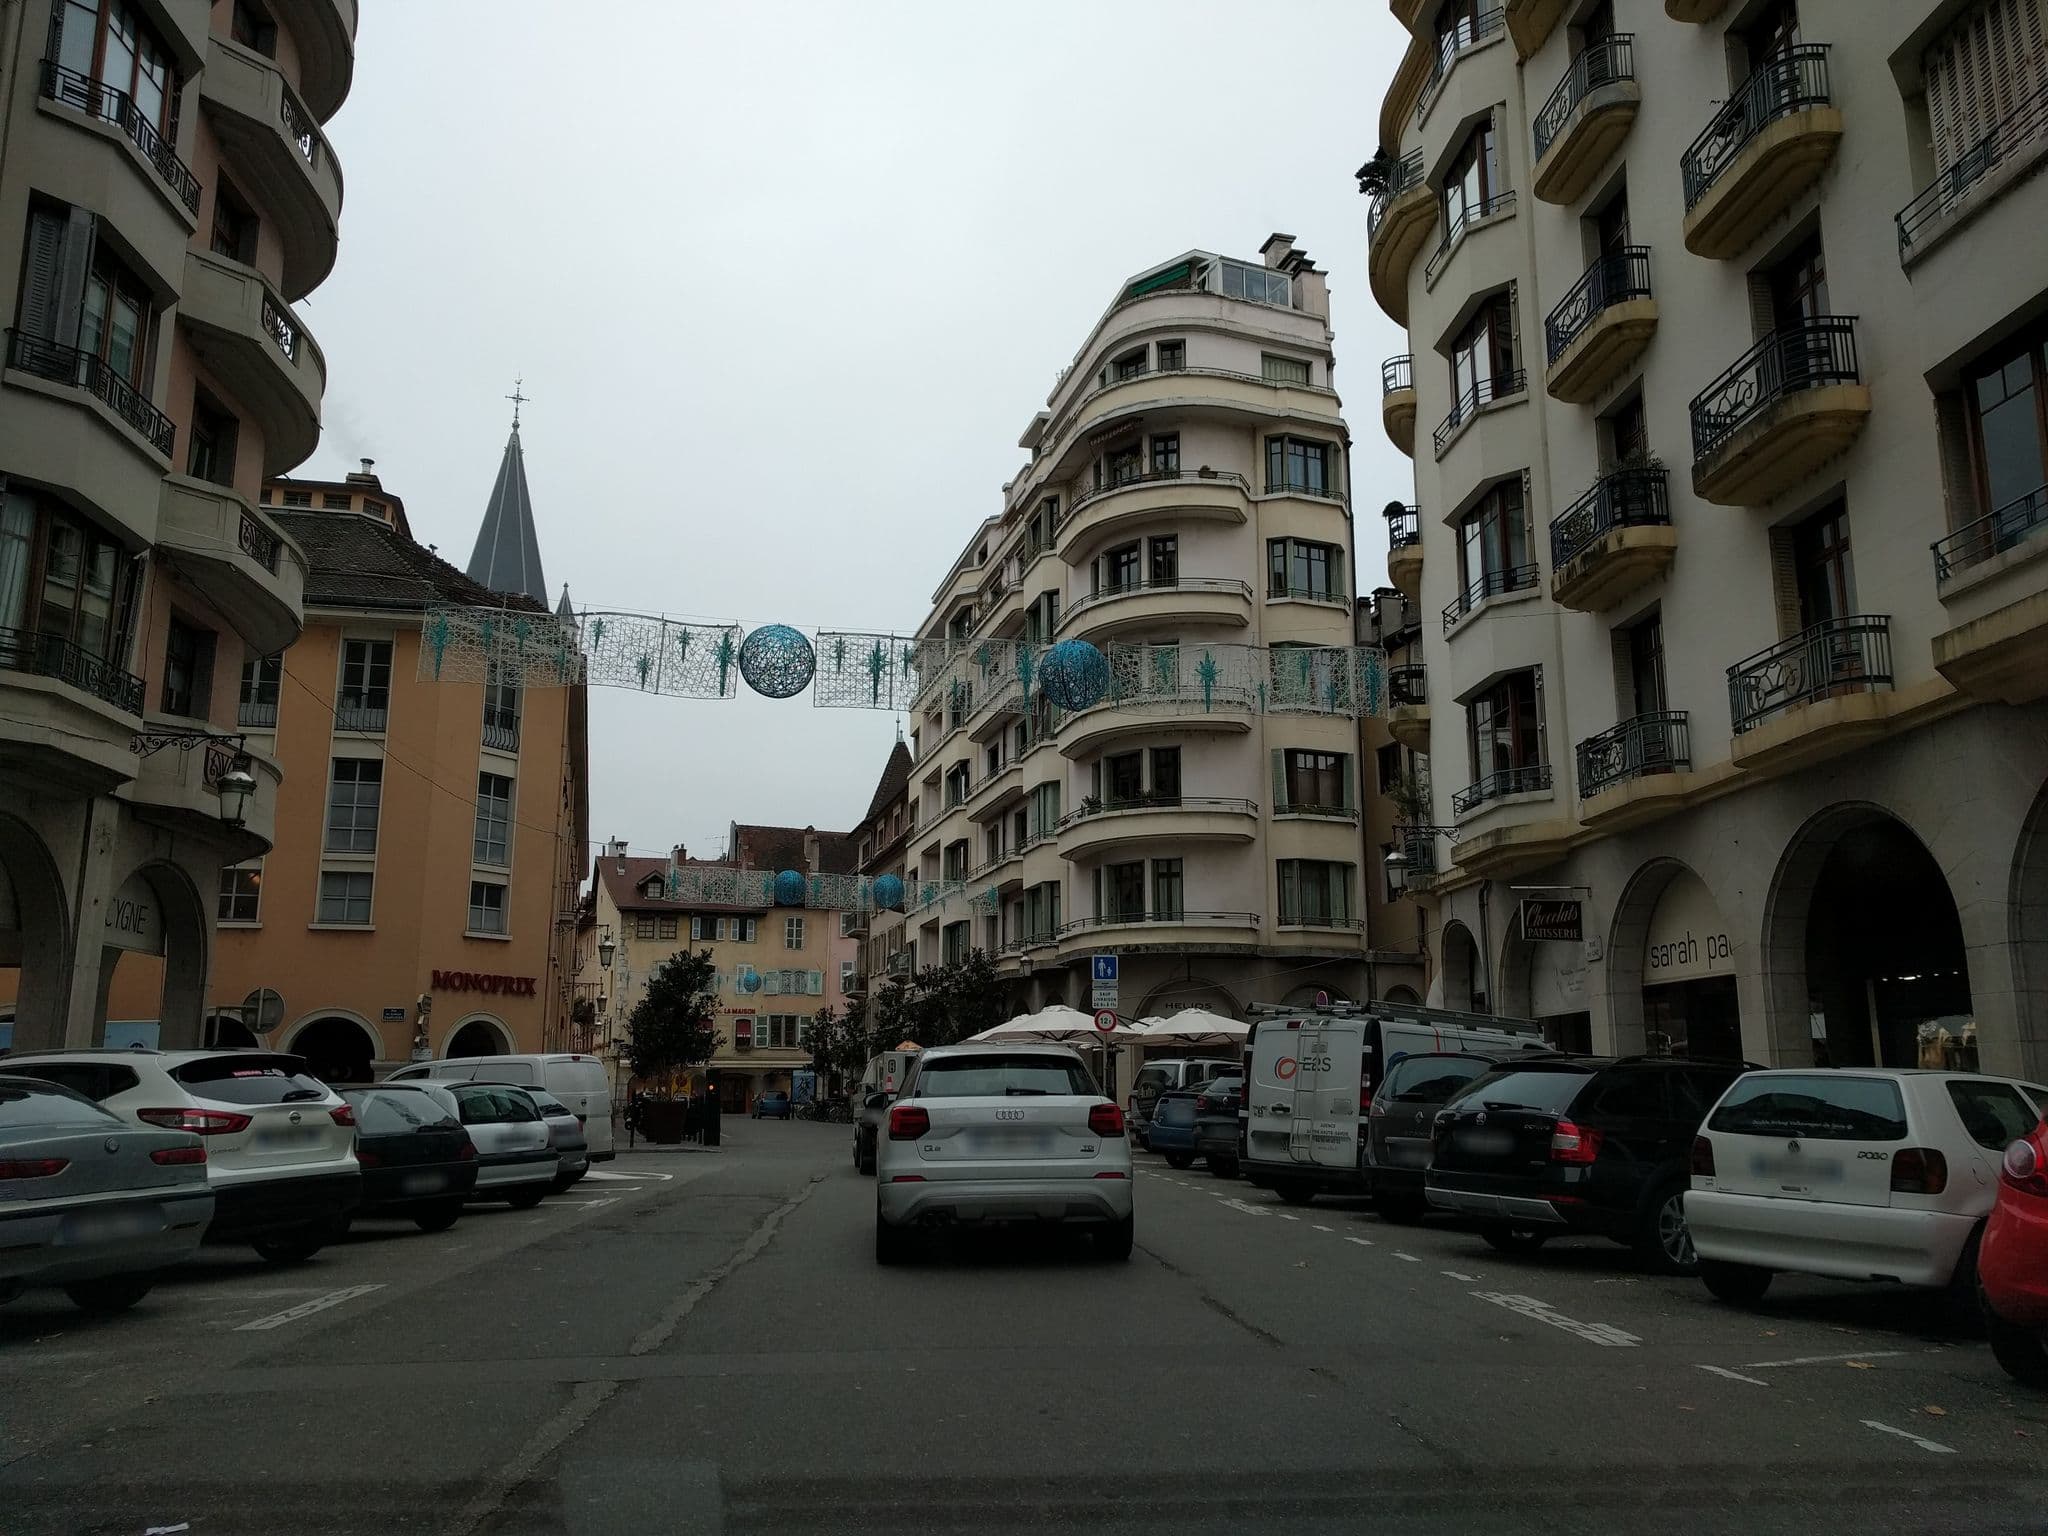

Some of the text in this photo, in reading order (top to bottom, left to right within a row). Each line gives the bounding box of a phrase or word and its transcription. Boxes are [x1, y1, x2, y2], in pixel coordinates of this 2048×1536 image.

[1526, 902, 1578, 927] Chocolats
[1651, 930, 1733, 970] sarah pa
[431, 969, 538, 996] MONOPRIX
